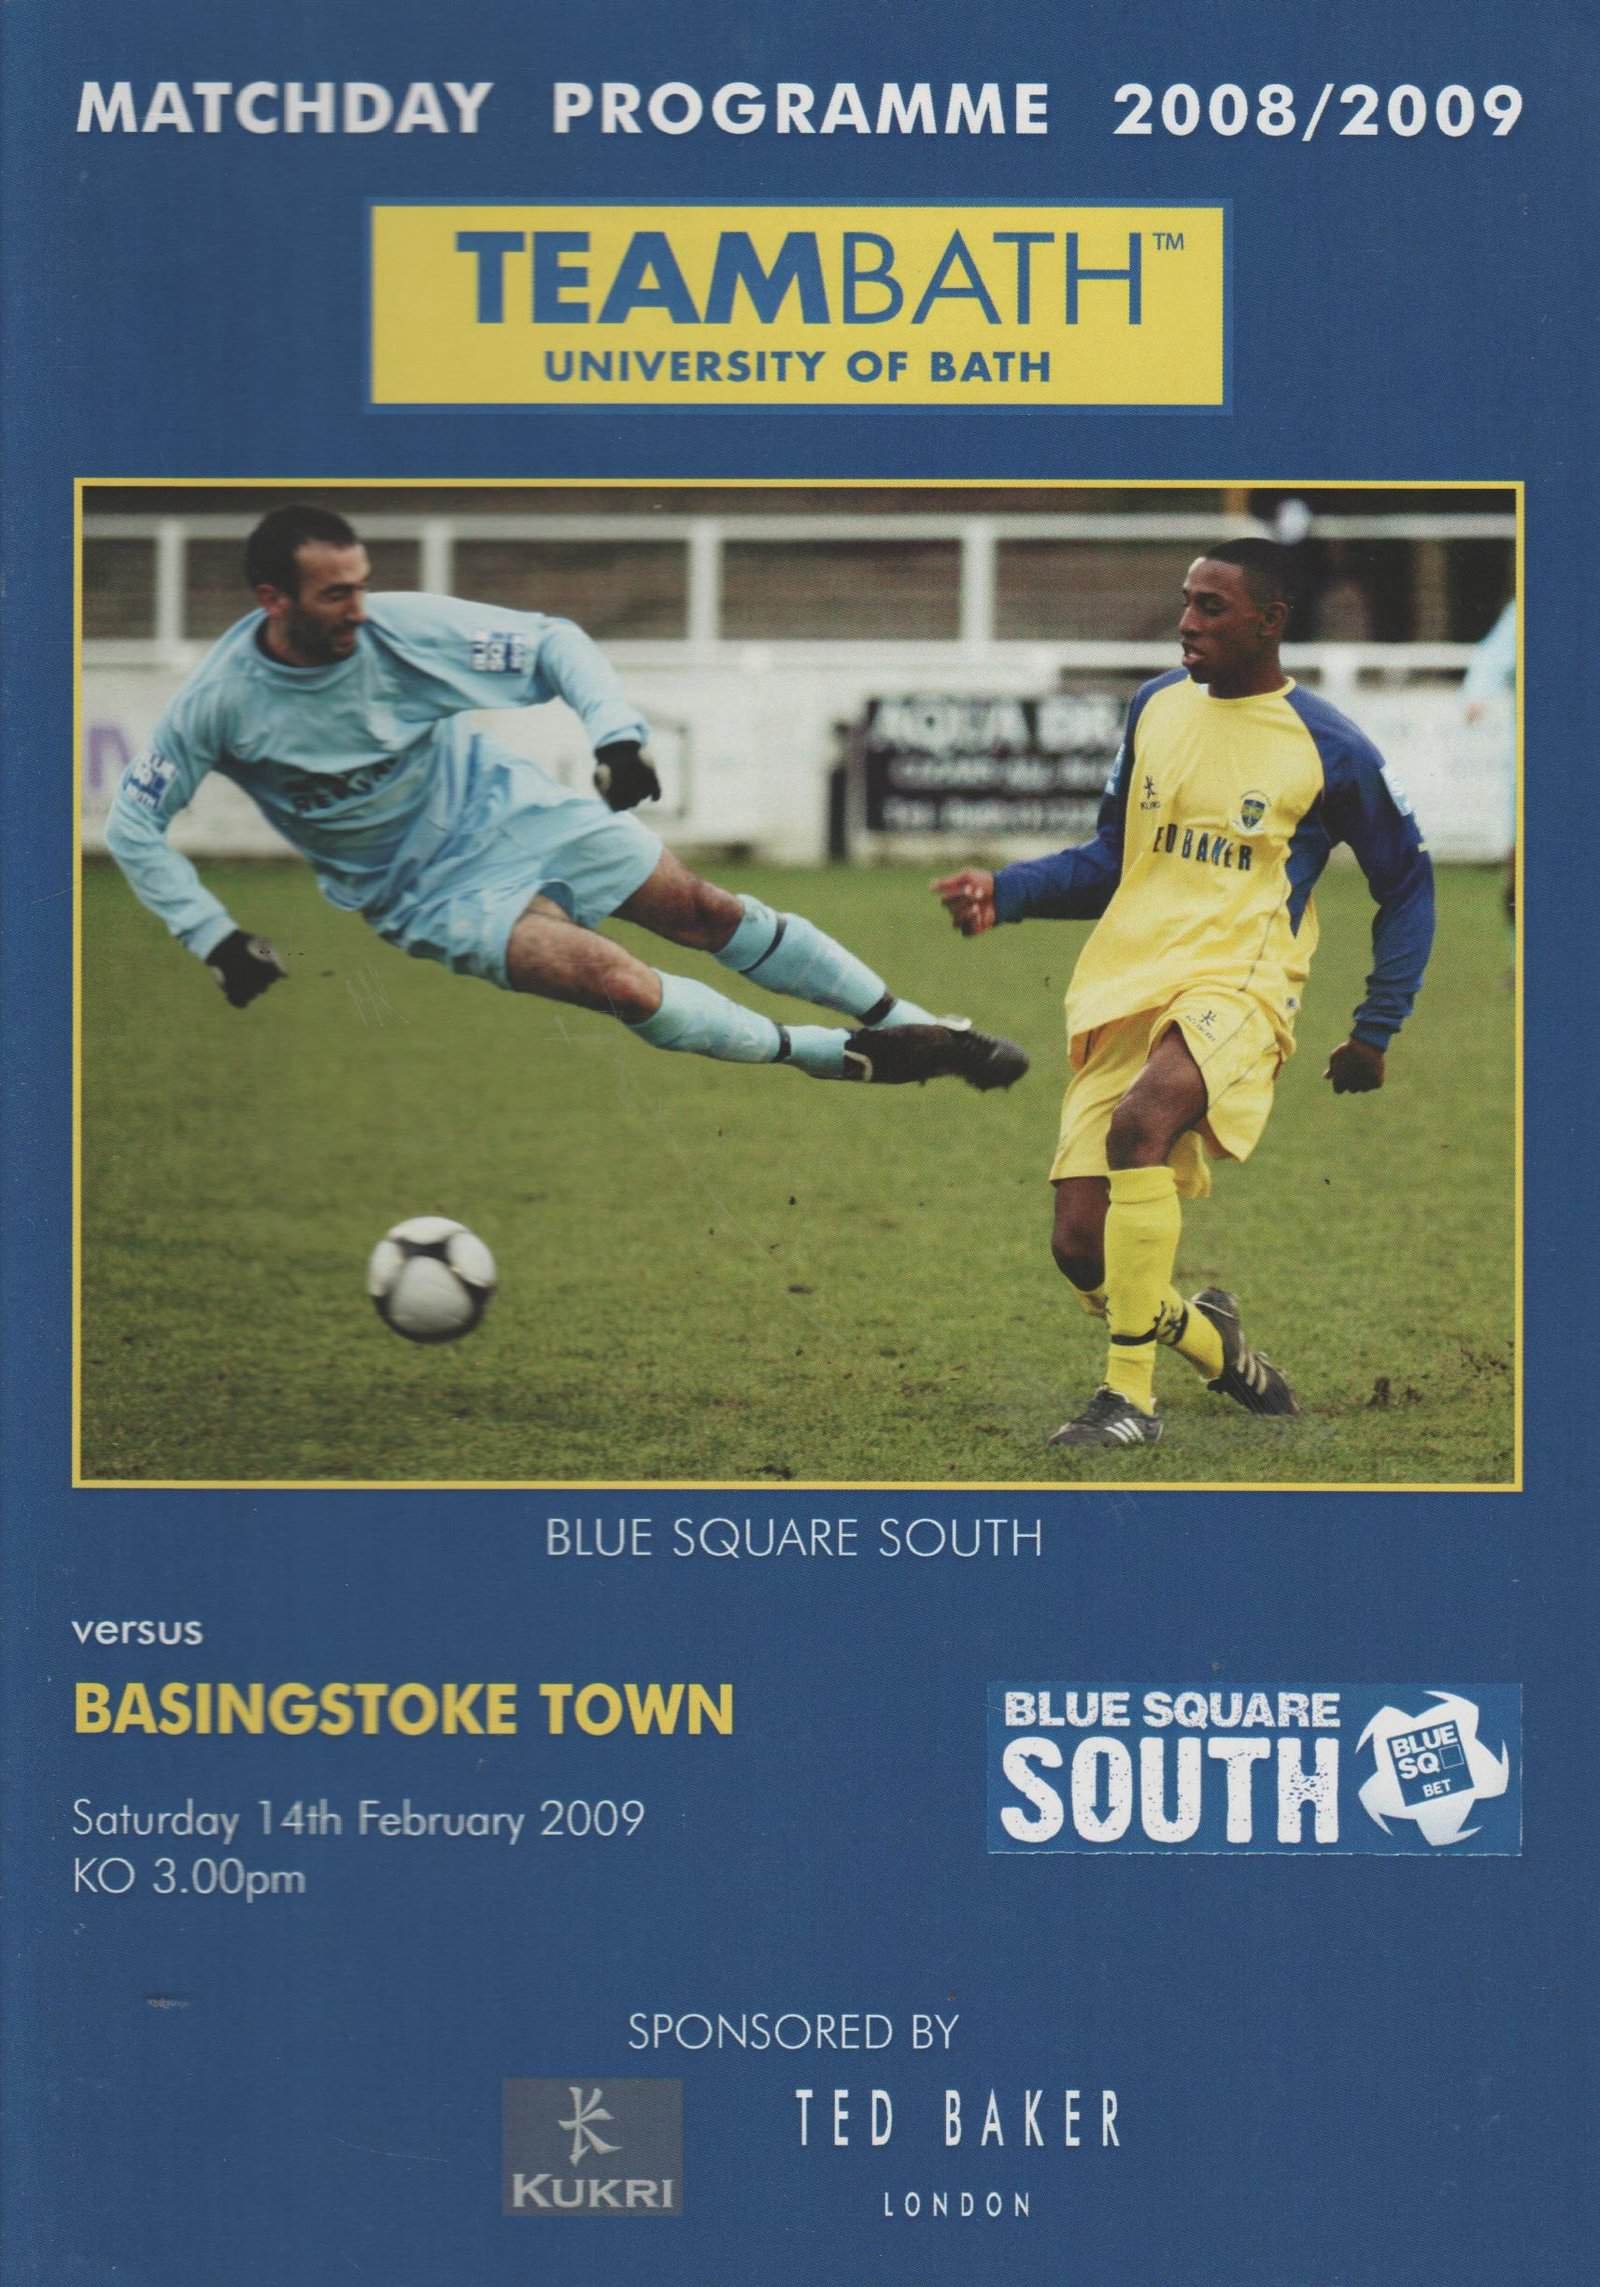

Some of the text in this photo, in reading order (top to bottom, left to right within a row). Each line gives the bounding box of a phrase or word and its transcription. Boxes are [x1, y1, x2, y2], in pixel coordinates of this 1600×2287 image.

[76, 82, 1524, 142] MATCHDAY PROGRAMME 2008/2009
[544, 351, 1052, 385] UNIVERSITY OF BATH
[1181, 829, 1253, 871] BAKER
[547, 1518, 1042, 1561] BLUE SQUARE SOUTH
[72, 1620, 204, 1647] versus
[75, 1683, 735, 1737] BASINGSTOKE TOWN
[1004, 1691, 1343, 1731] BLUE SQUARE
[1391, 1724, 1458, 1759] BLUE
[1398, 1752, 1441, 1780] SQ
[1000, 1736, 1341, 1846] SOUTH
[1422, 1778, 1452, 1798] BET
[73, 1799, 646, 1847] Saturday 14th February 2009
[74, 1858, 306, 1905] KO 3.00pm
[629, 2012, 961, 2051] SPONSORED BY
[796, 2089, 1122, 2148] TED BAKER
[513, 2173, 674, 2210] KUKRI
[885, 2192, 1031, 2218] LONDON
